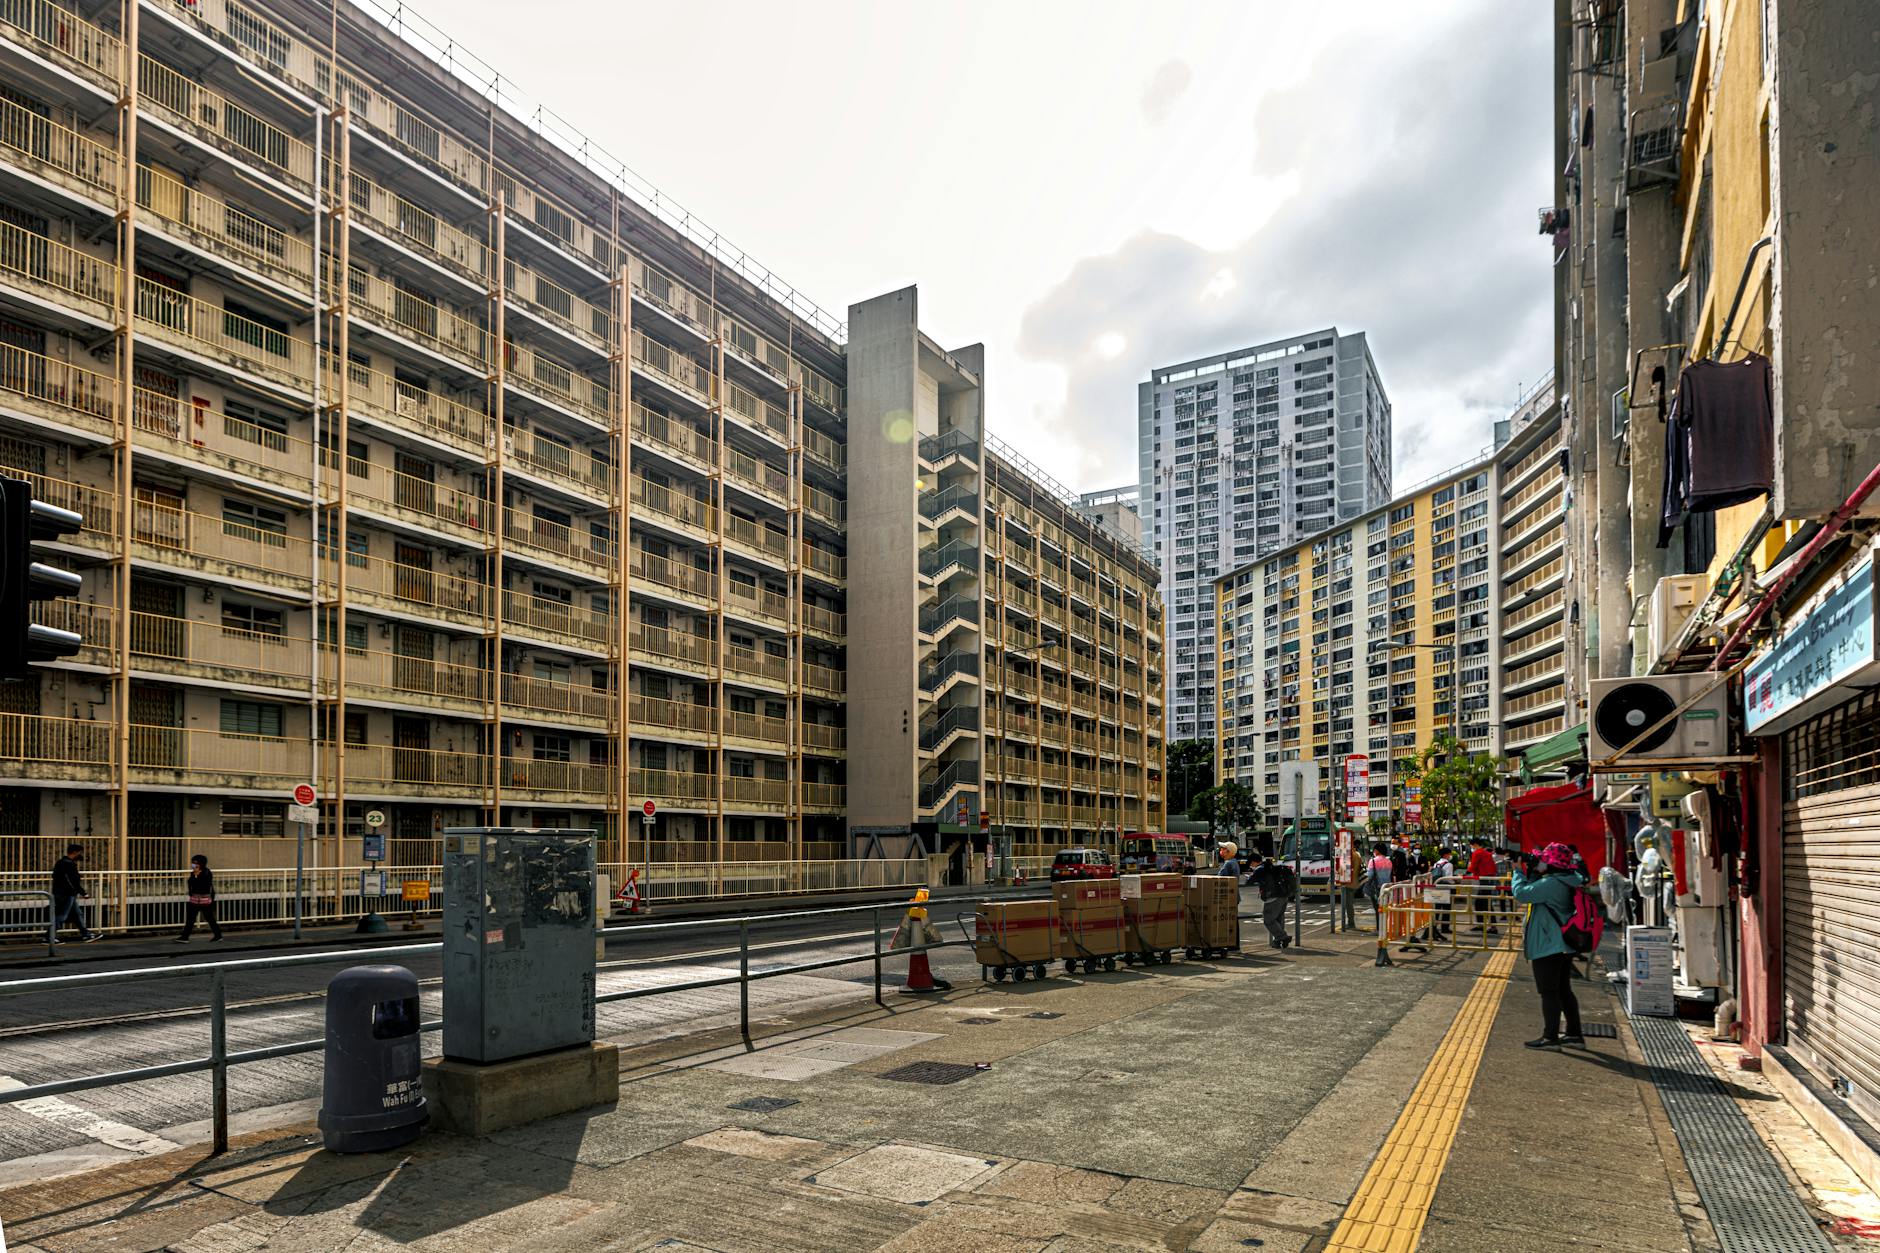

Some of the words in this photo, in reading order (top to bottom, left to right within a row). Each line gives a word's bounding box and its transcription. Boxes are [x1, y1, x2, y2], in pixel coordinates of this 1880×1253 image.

[369, 815, 382, 823] 23
[382, 1095, 399, 1108] Wah
[400, 1093, 408, 1105] Fu
